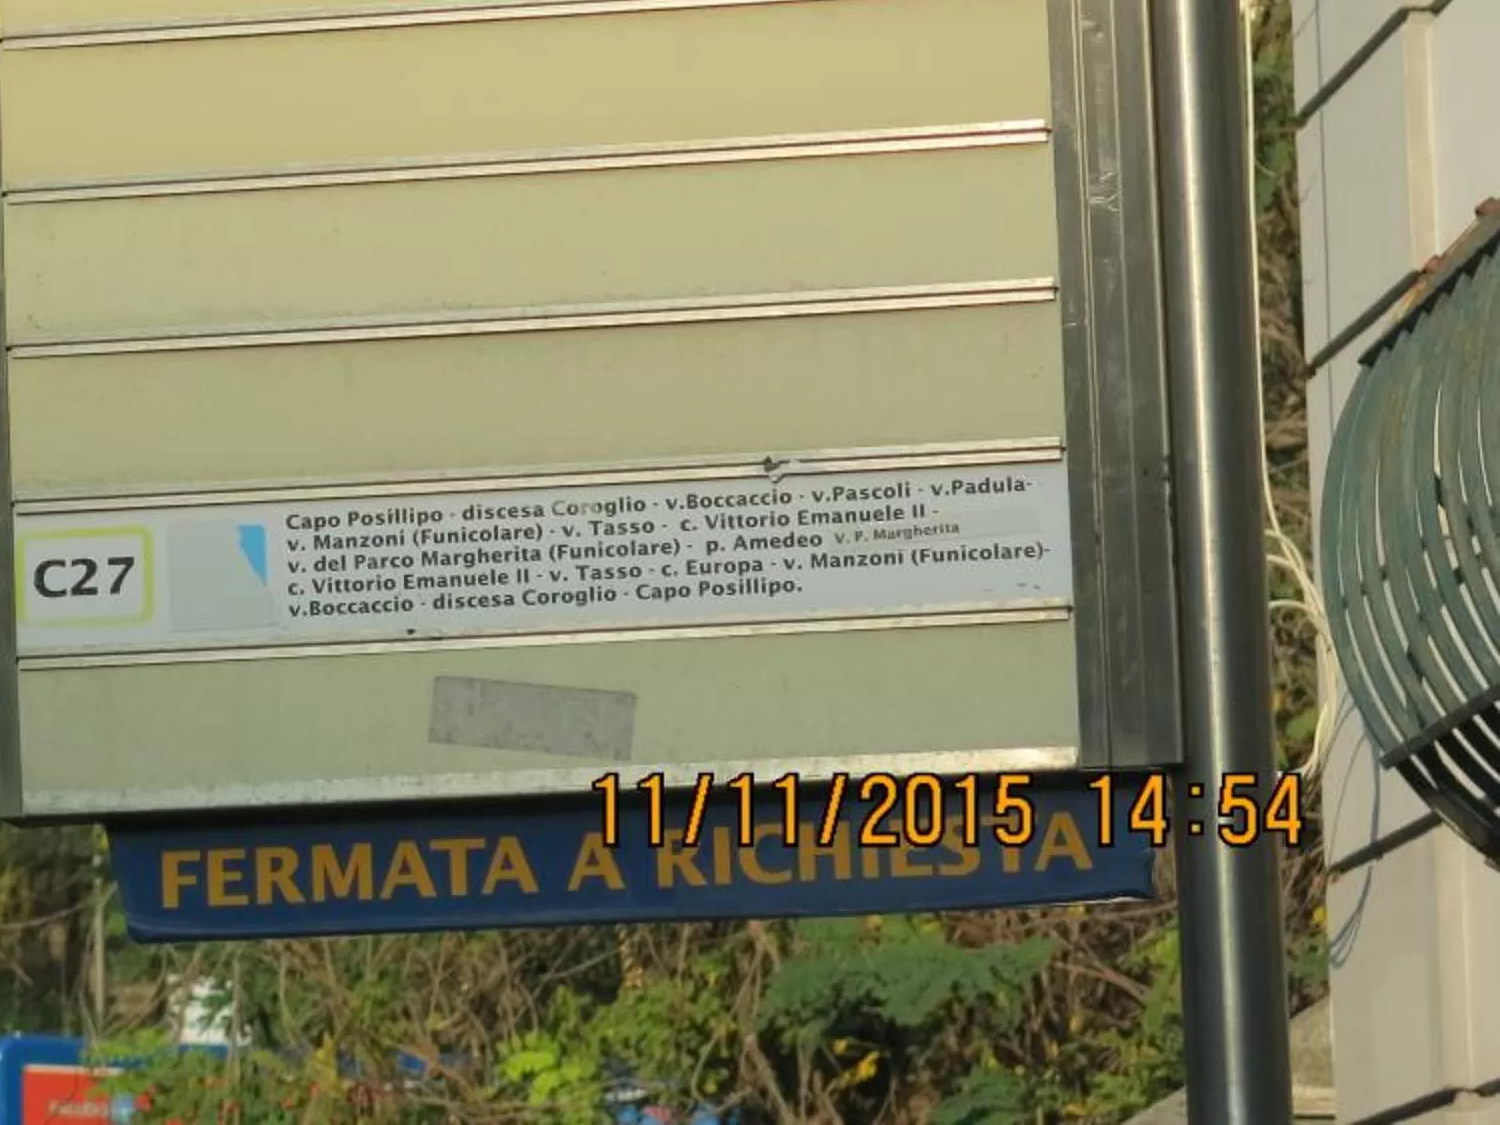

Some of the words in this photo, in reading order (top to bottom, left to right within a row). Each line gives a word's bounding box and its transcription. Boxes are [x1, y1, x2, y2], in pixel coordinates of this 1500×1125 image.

[285, 514, 341, 531] Capo
[347, 507, 443, 526] Posillipo
[462, 504, 545, 521] discesa
[551, 496, 647, 517] Coroglio
[665, 489, 792, 510] v.Boccaccio
[811, 481, 911, 503] v.Pascoli
[286, 538, 306, 552] v.
[312, 529, 405, 550] Manzoni
[412, 523, 543, 548] (Funicolare)
[561, 525, 581, 538] v.
[588, 520, 655, 536] Tasso
[680, 519, 698, 532] c.
[704, 511, 790, 530] Vittorio
[797, 504, 905, 526] Emanuele
[912, 503, 926, 519] II
[287, 561, 307, 574] v.
[313, 554, 347, 572] del
[354, 554, 414, 571] Parco
[421, 545, 542, 568] Margherita
[549, 538, 681, 563] (Funicolare)
[706, 540, 726, 556] p.
[733, 532, 823, 551] Amedeo
[874, 523, 960, 540] Margherita
[287, 582, 305, 595] c.
[312, 575, 396, 594] Vittorio
[403, 569, 509, 590] Emanuele
[516, 569, 529, 584] II
[549, 571, 568, 582] v.
[575, 565, 643, 581] Tasso
[661, 564, 679, 576] c.
[686, 559, 763, 576] Europa
[783, 558, 803, 570] v.
[810, 549, 904, 569] Manzoni
[33, 556, 135, 598] C27
[289, 596, 414, 617] v.Boccaccio
[432, 593, 515, 610] discesa
[522, 586, 617, 607] Coroglio
[635, 584, 691, 601] Capo
[699, 577, 803, 597] Posillipo.
[160, 835, 539, 909] FERMATA
[568, 831, 626, 892] A
